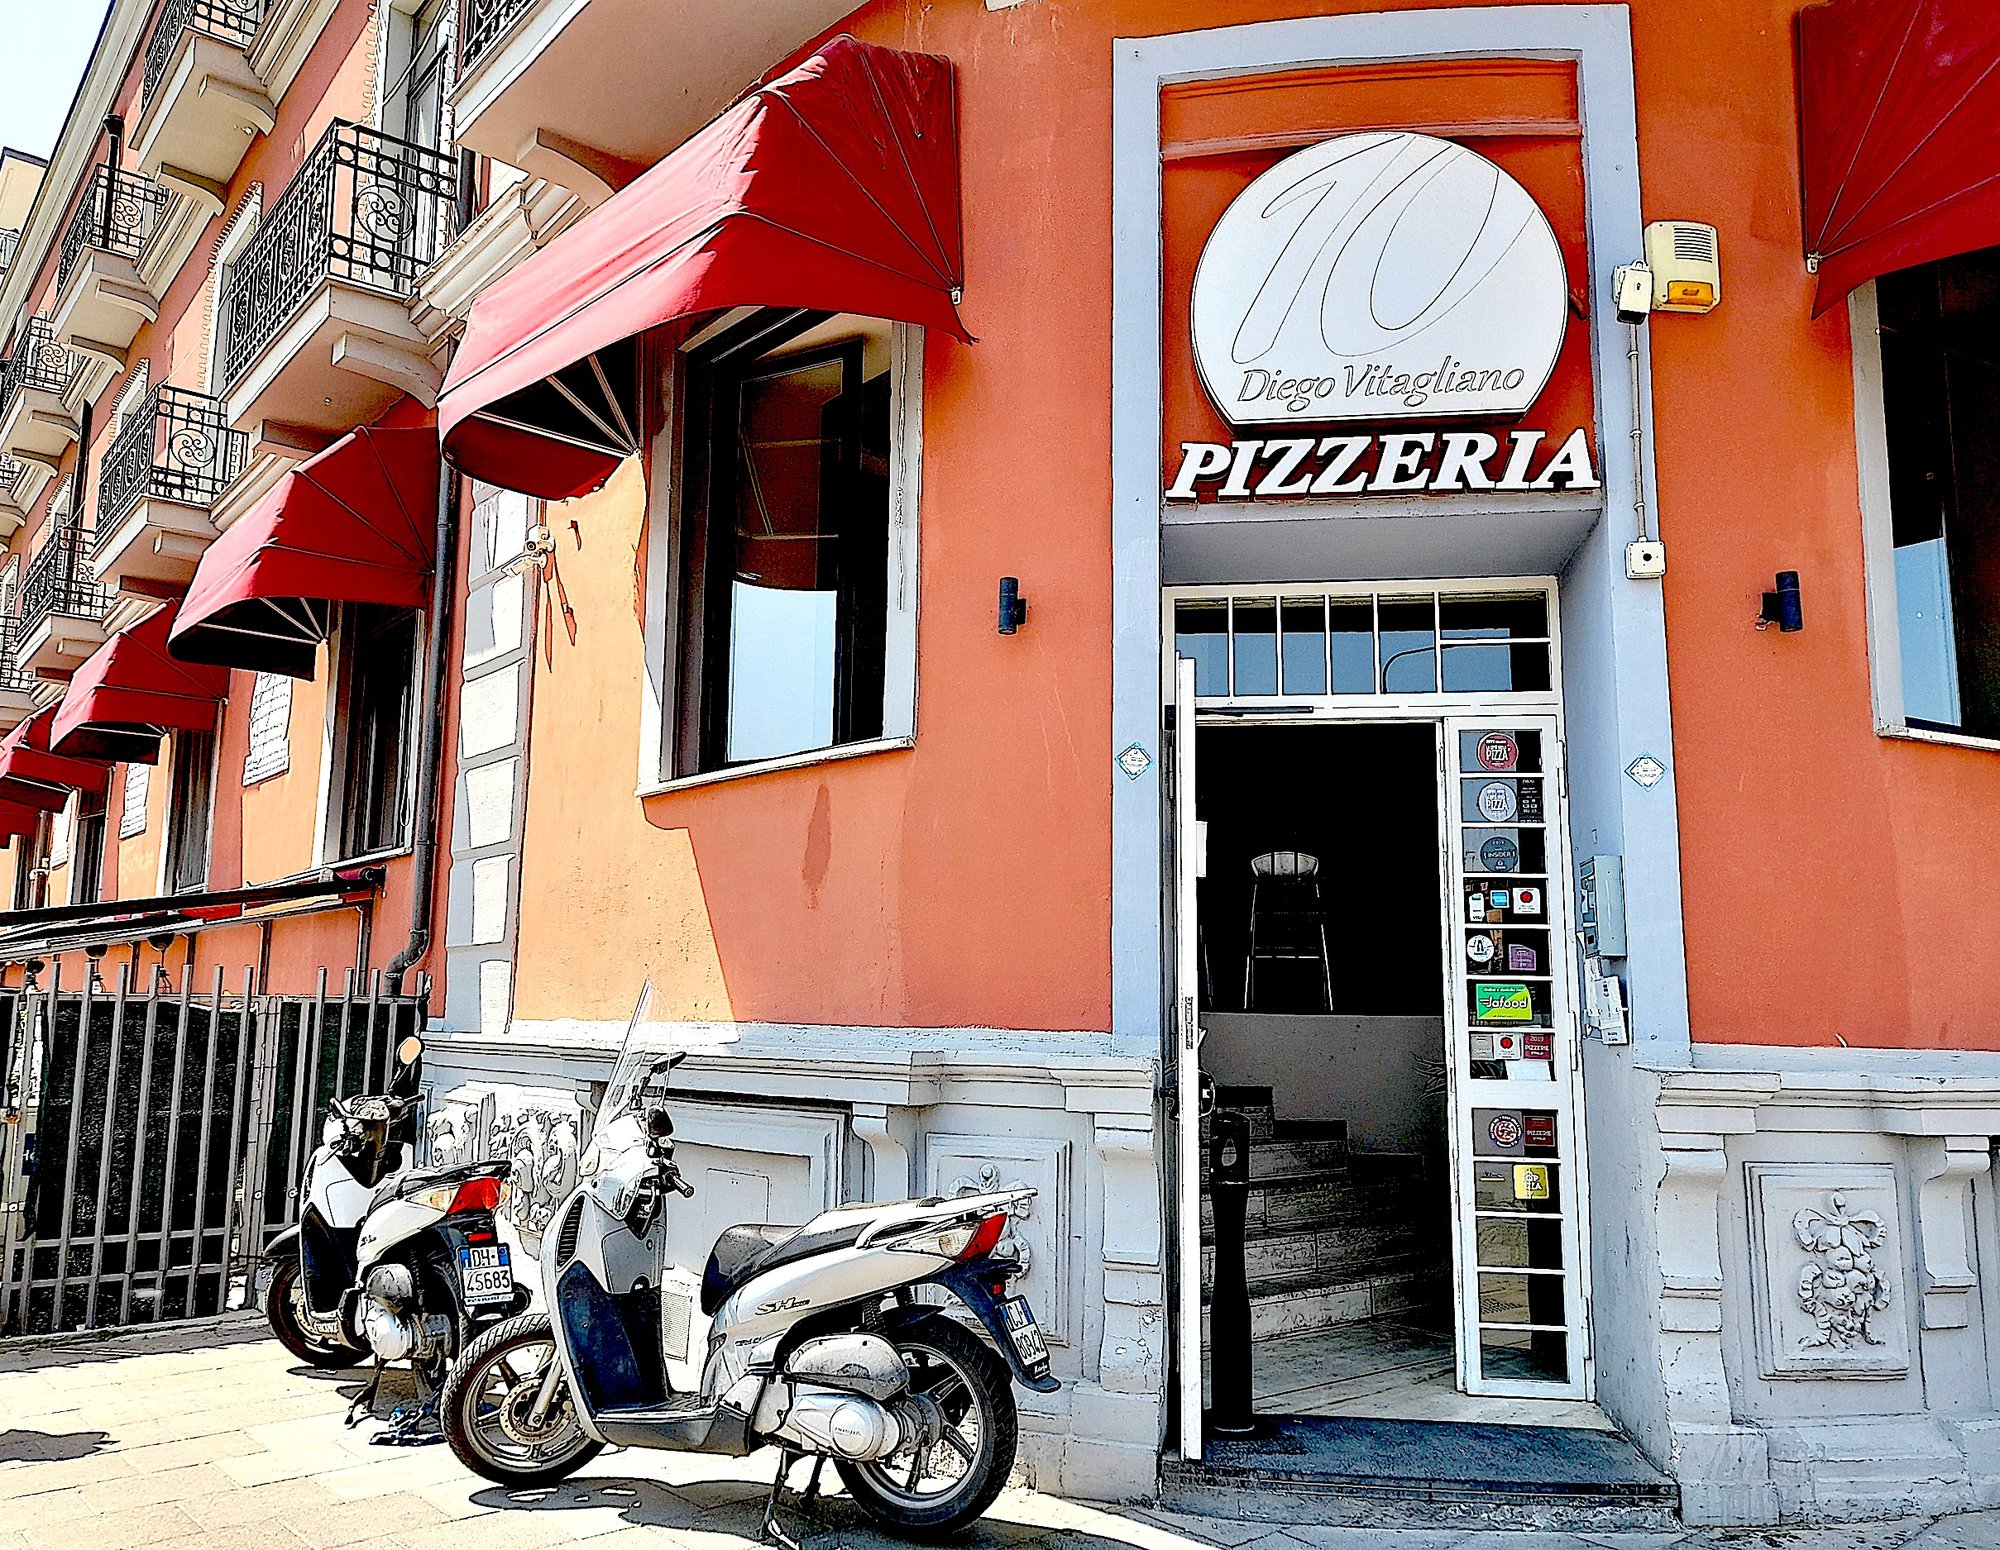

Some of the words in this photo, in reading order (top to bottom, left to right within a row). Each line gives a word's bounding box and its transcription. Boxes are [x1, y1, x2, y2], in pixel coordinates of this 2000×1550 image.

[1237, 369, 1336, 412] Diego
[1343, 355, 1526, 408] Vitagliano
[1165, 427, 1601, 500] PIZZERIA
[1486, 748, 1509, 761] PIZZA
[1486, 798, 1508, 811] PIZZA
